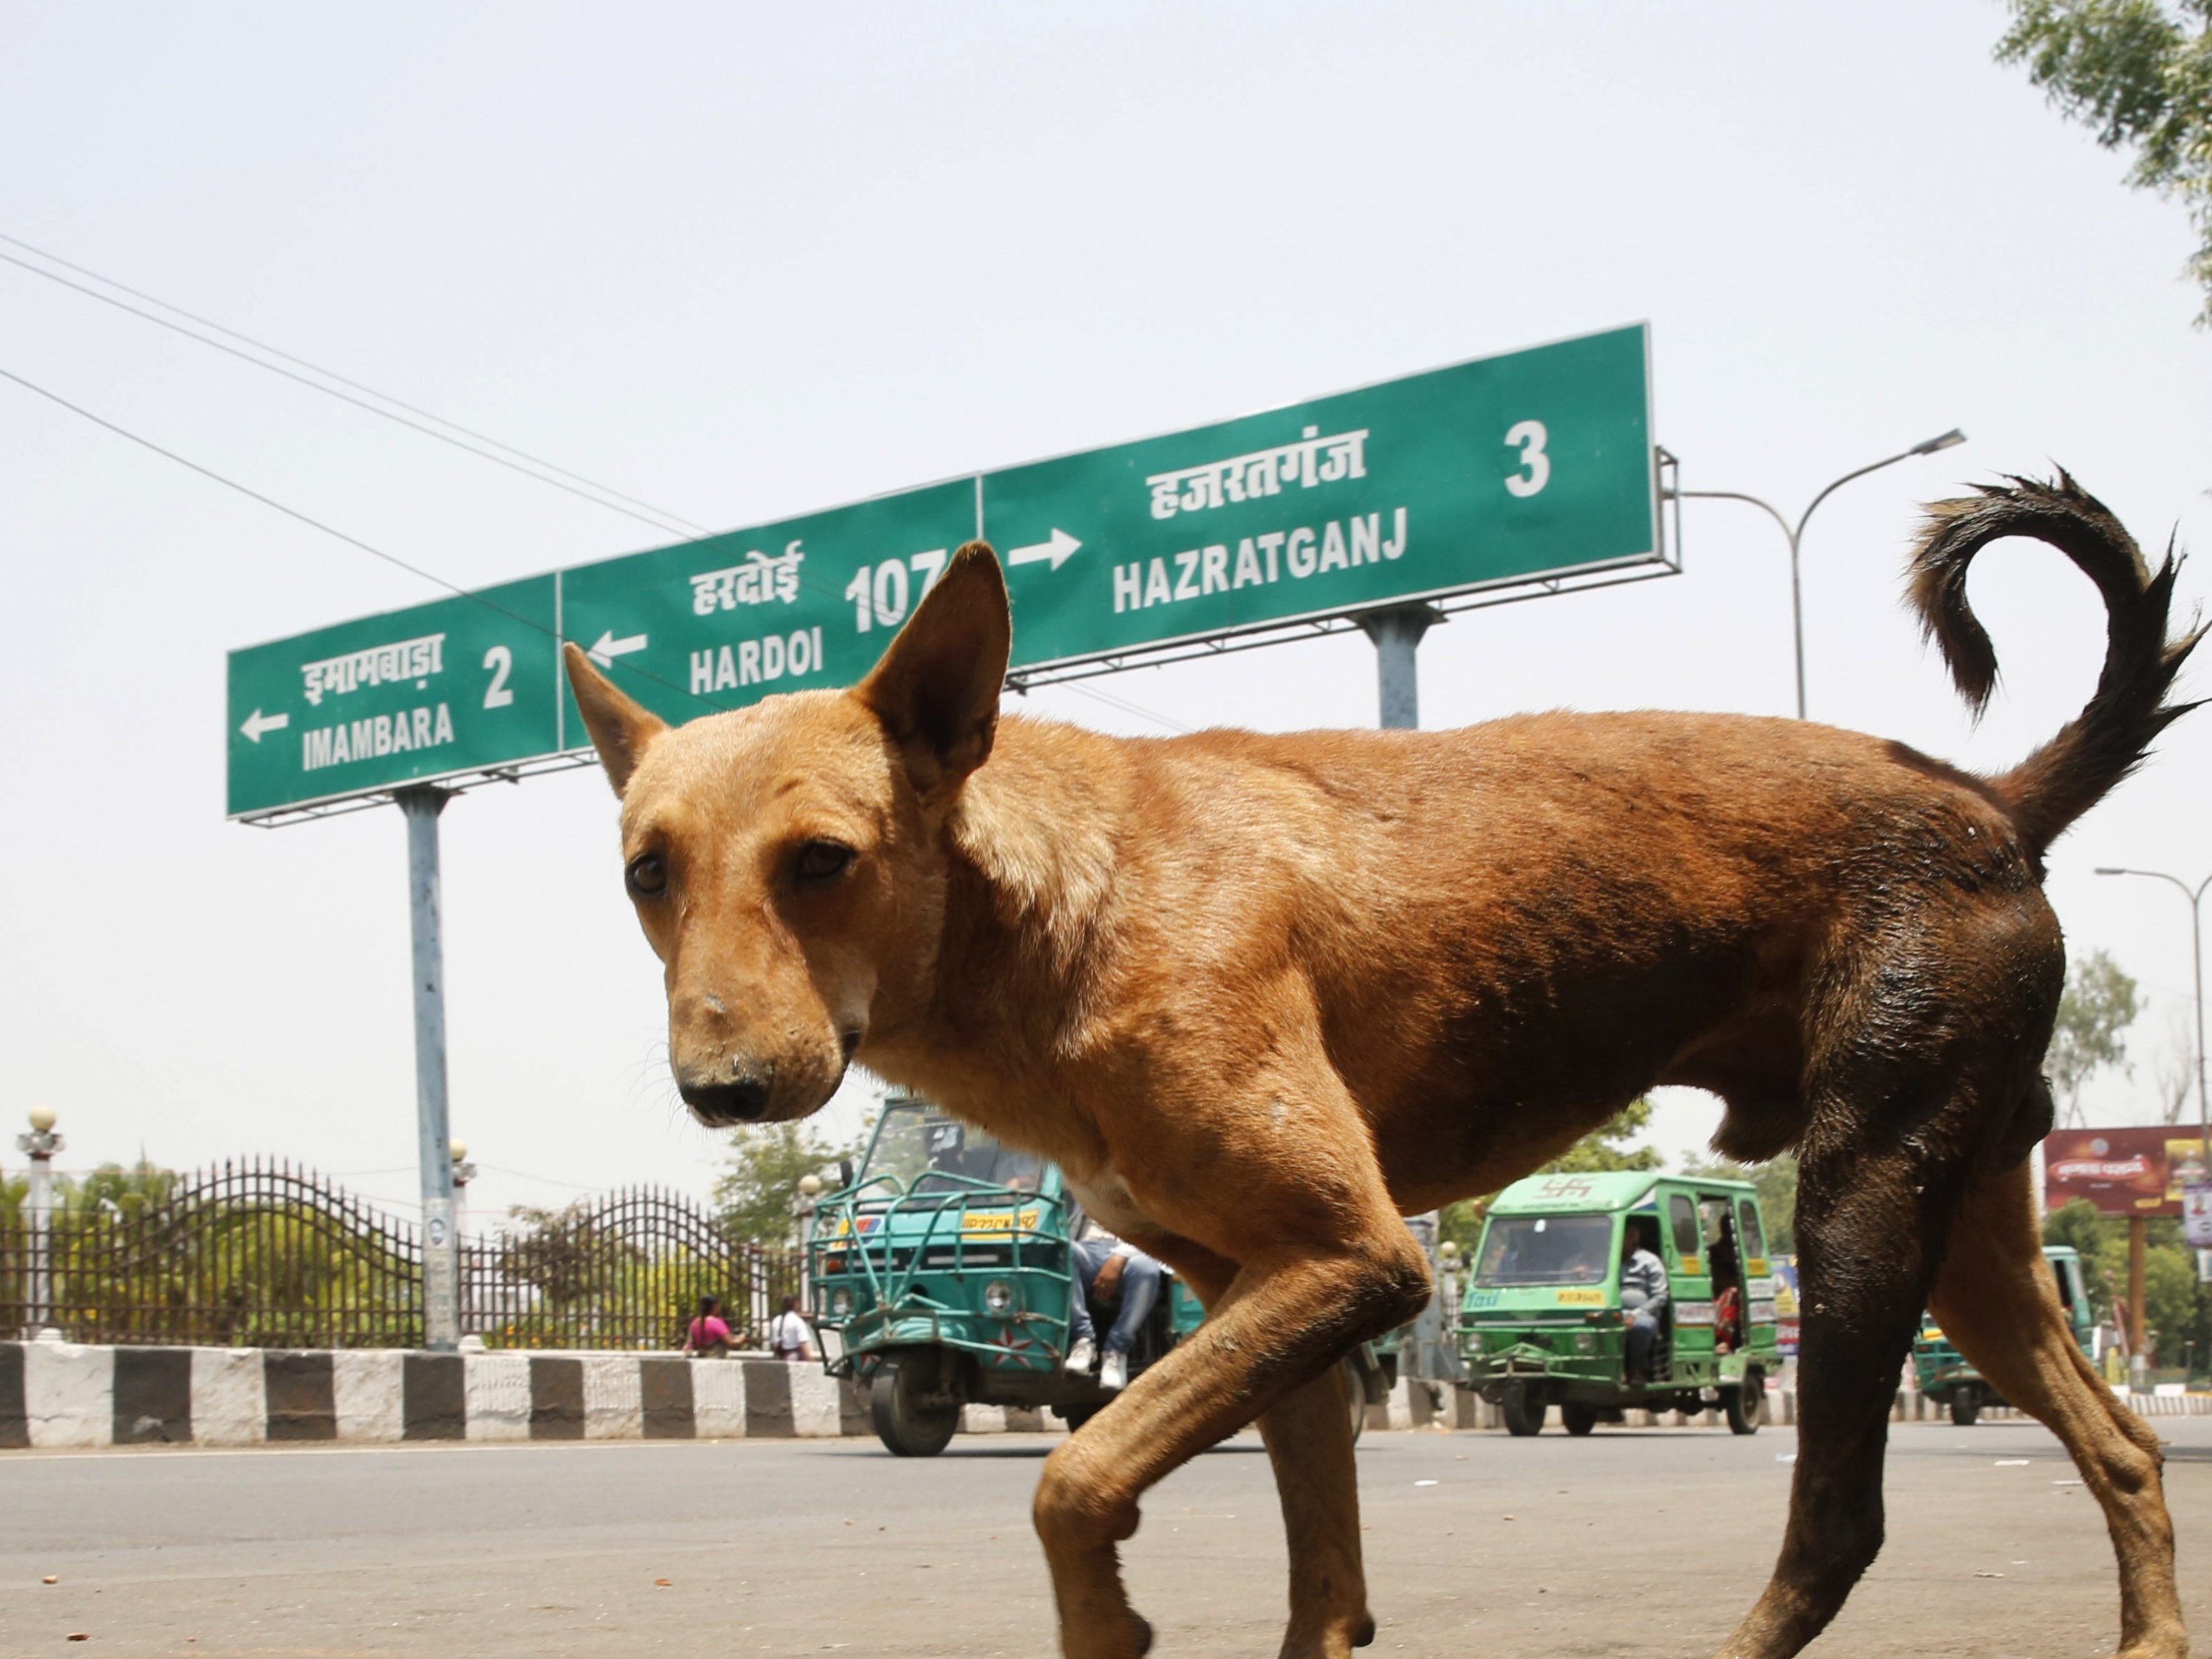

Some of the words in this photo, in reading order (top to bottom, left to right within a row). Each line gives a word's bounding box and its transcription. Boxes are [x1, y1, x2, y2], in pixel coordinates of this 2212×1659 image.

[1145, 425, 1370, 520] हजरतगंज
[1505, 420, 1550, 497] 3
[689, 539, 805, 615] हरदोई
[845, 548, 947, 633] 107
[1113, 507, 1408, 614] HAZRATGANJ
[301, 633, 447, 706] इमामबाड़ा
[483, 646, 513, 709] 2
[690, 627, 822, 695] HARDOI
[303, 702, 454, 772] IMAMBARA
